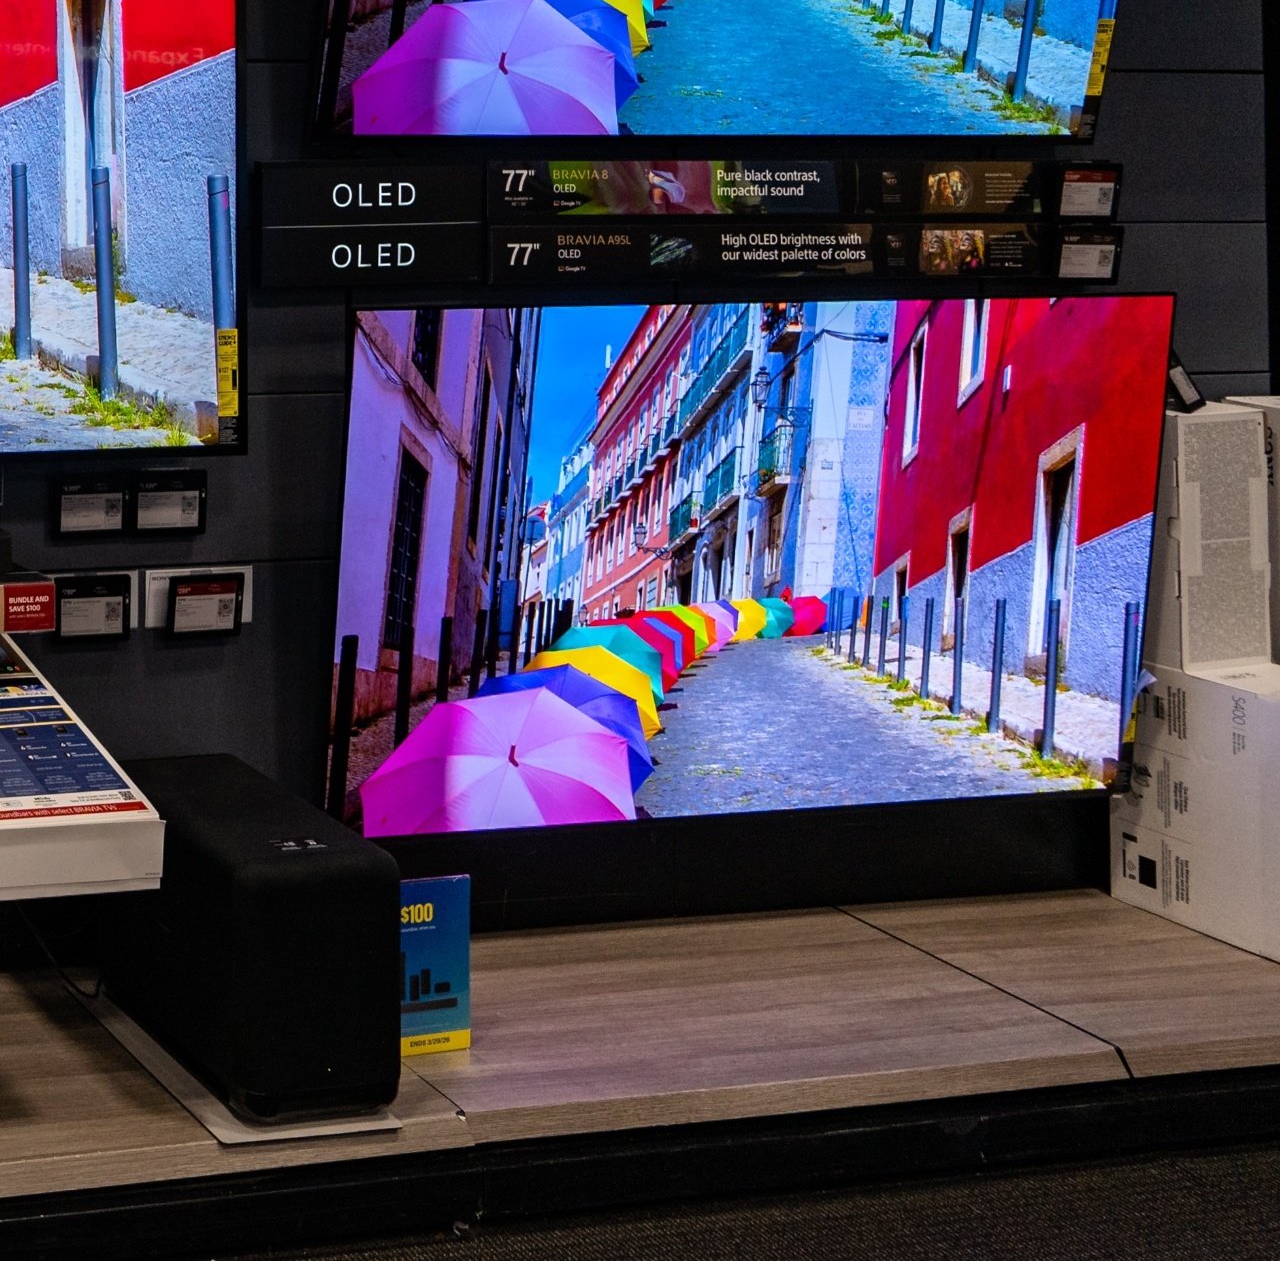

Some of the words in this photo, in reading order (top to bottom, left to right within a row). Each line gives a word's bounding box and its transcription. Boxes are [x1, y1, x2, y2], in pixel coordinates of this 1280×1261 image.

[502, 169, 536, 192] 77"
[552, 169, 600, 179] BRAVIA
[601, 169, 609, 180] 8
[717, 169, 741, 181] Pure
[744, 169, 772, 181] black
[774, 170, 820, 183] contrast,
[332, 182, 416, 208] OLED
[553, 184, 577, 193] OLED
[717, 184, 768, 198] impactful
[770, 184, 804, 196] sound
[557, 235, 605, 245] BRAVIA
[608, 234, 632, 245] A95L
[721, 233, 746, 248] High
[749, 233, 777, 245] OLED
[780, 233, 836, 247] brightness
[838, 233, 862, 245] with
[332, 243, 416, 269] OLED
[506, 242, 541, 266] 77"
[557, 249, 581, 258] OLED
[722, 250, 740, 260] our
[743, 249, 779, 260] widest
[781, 249, 819, 262] palette
[821, 248, 833, 260] of
[835, 248, 866, 260] colors
[8, 596, 34, 604] BUNDLE
[35, 595, 49, 603] AND
[8, 605, 25, 613] SAVE
[26, 604, 41, 612] $100
[1231, 695, 1247, 726] S400
[35, 809, 50, 817] with
[52, 807, 73, 815] select
[74, 805, 103, 813] BRAVIA
[400, 902, 434, 925] $100
[409, 1038, 427, 1048] ENDS
